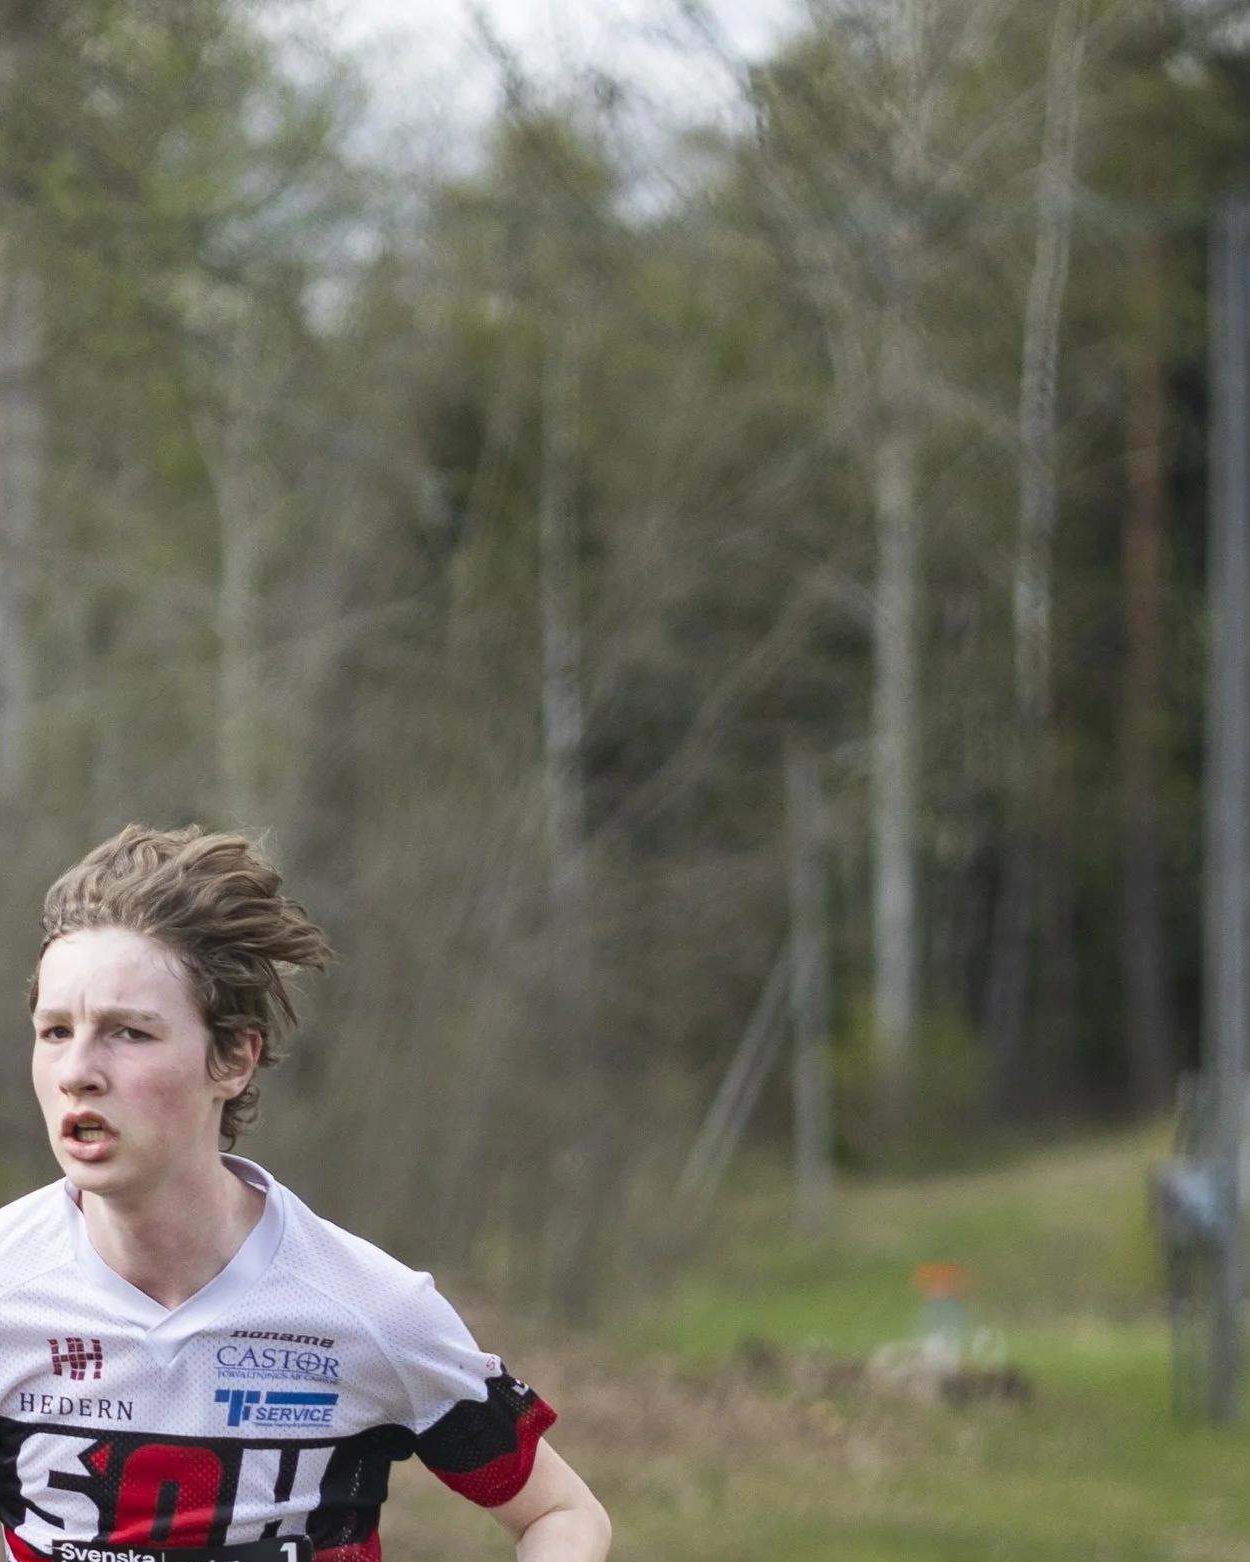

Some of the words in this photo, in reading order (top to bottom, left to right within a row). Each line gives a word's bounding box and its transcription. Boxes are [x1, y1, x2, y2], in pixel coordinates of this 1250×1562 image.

[230, 1330, 335, 1349] noname
[216, 1345, 340, 1378] CASTOR
[19, 1392, 134, 1421] HEDERN
[255, 1407, 334, 1422] SERVICE
